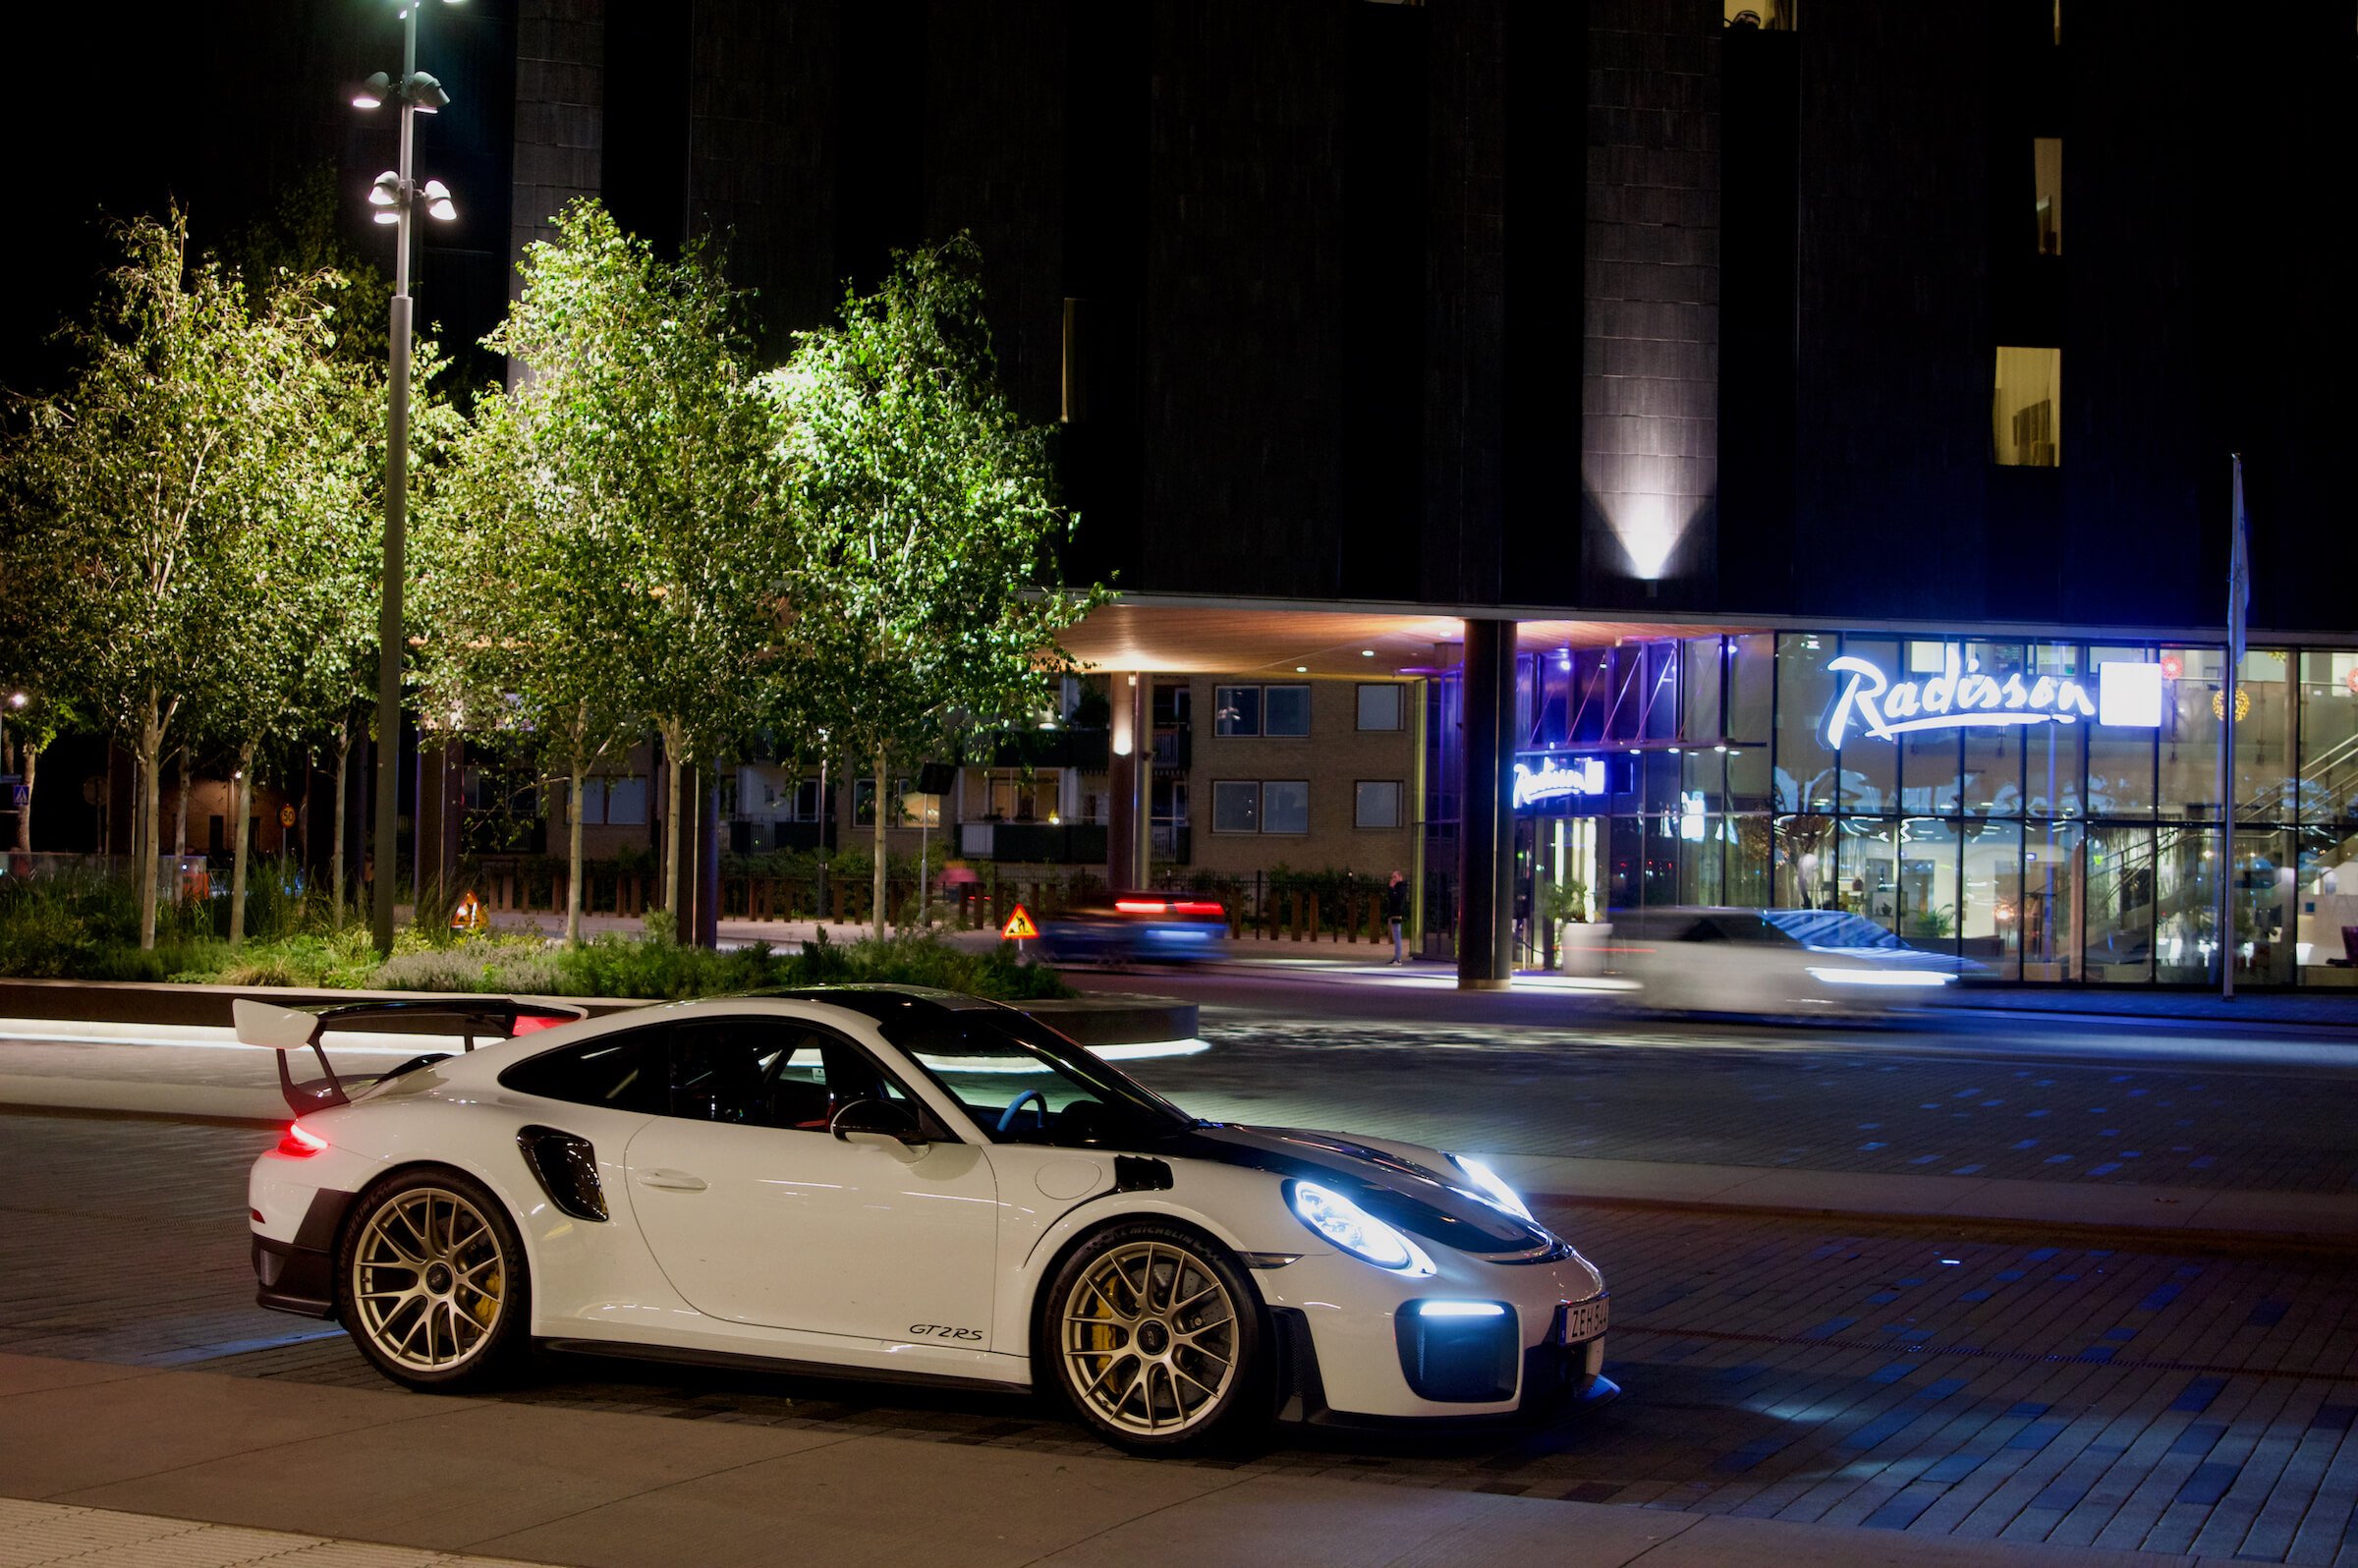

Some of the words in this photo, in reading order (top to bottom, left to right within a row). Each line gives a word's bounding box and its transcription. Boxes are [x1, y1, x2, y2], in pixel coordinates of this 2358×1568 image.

[1827, 646, 2096, 750] Radisson
[282, 811, 294, 822] 50
[1129, 1225, 1194, 1245] MICHELIN
